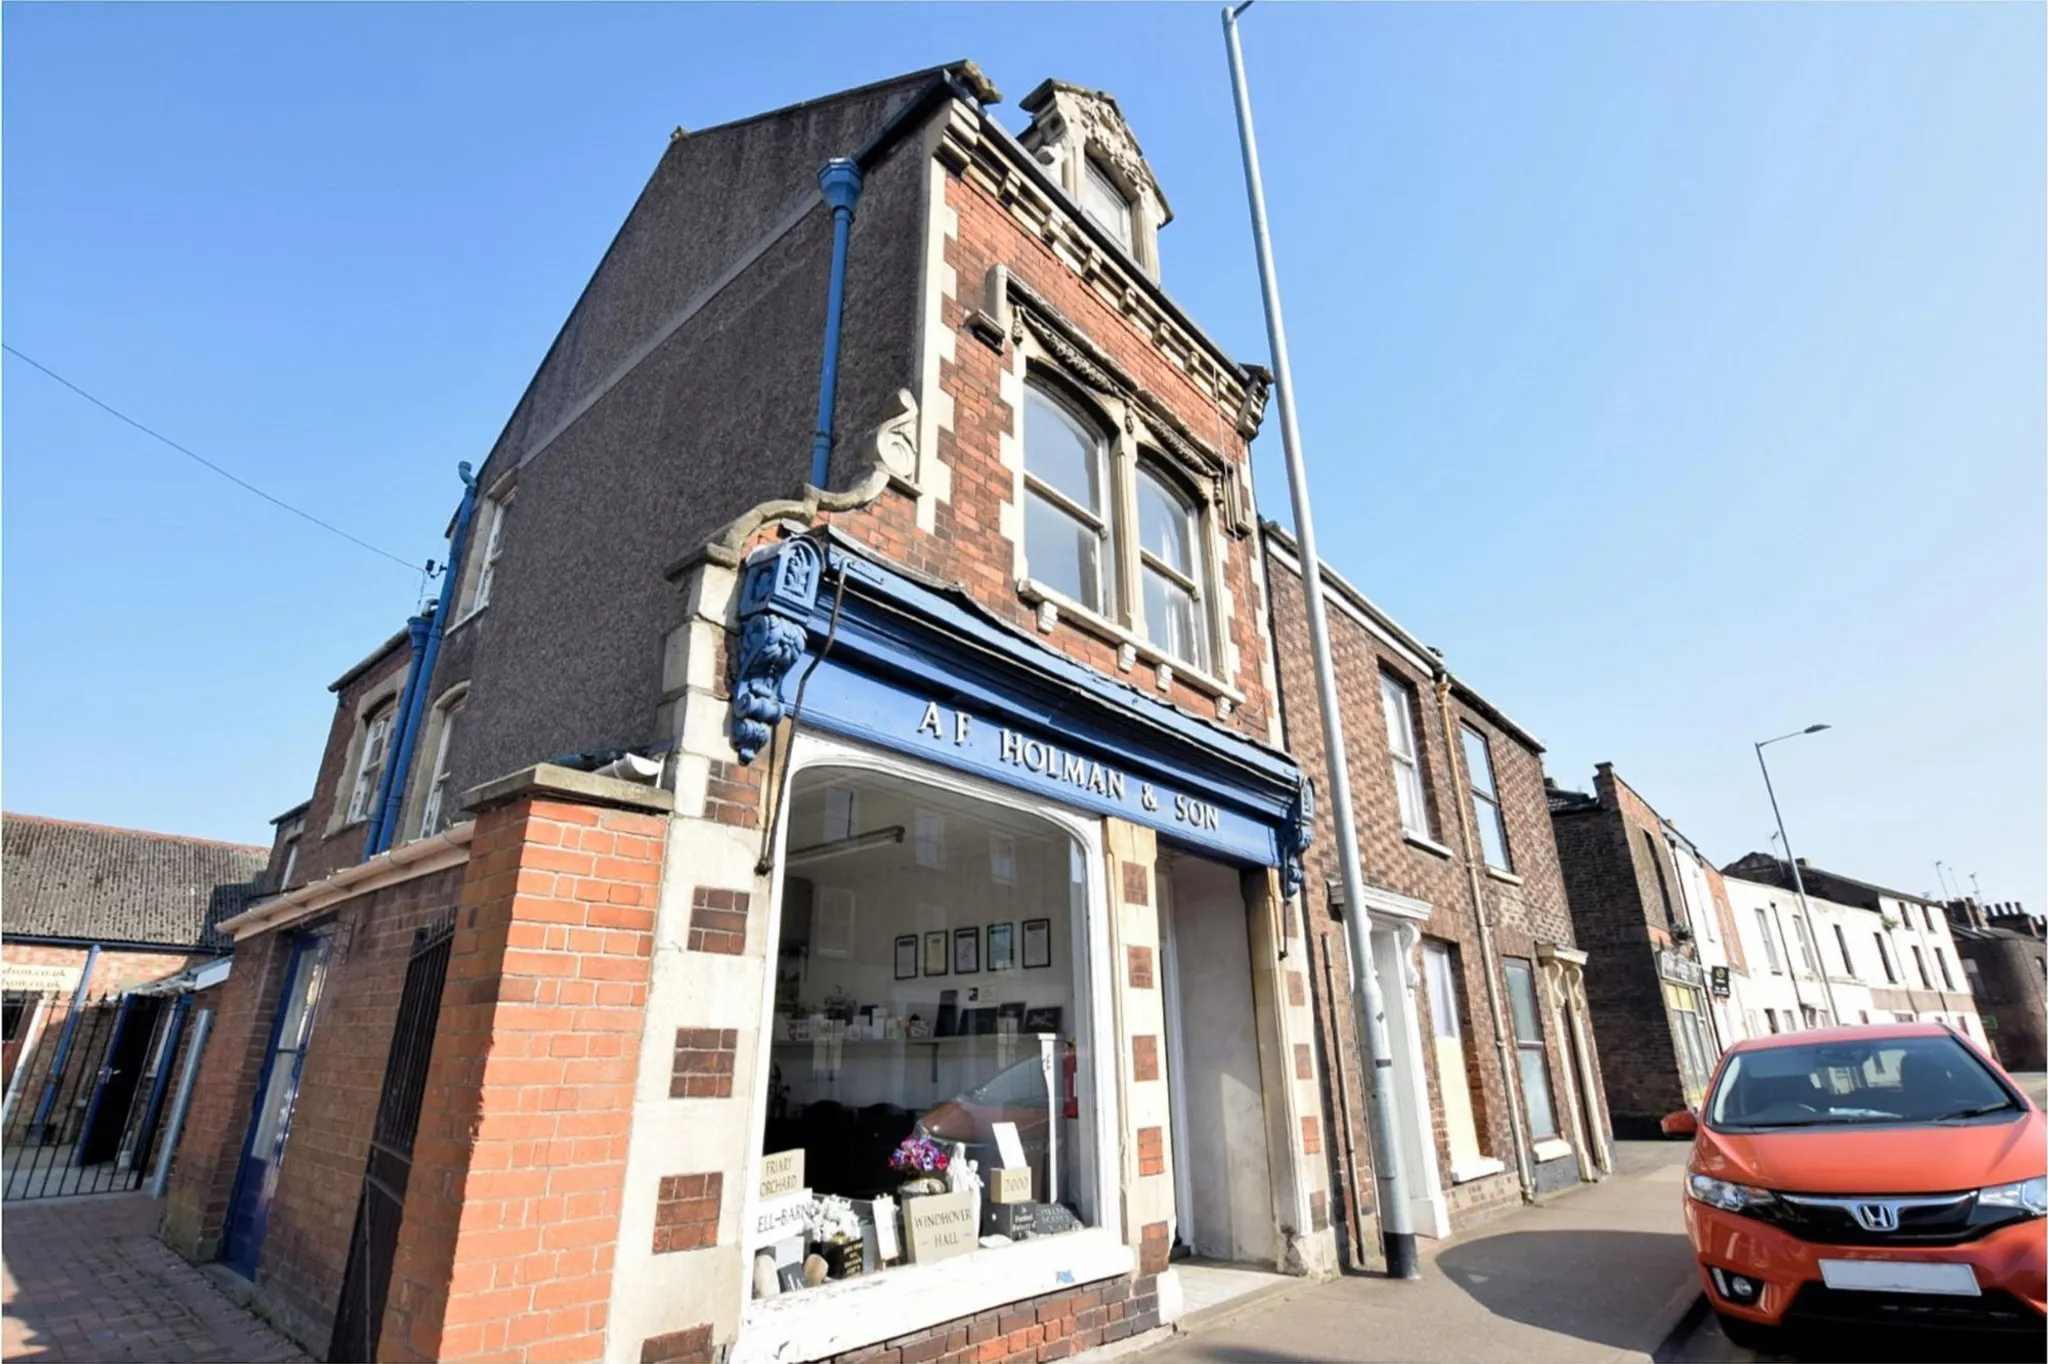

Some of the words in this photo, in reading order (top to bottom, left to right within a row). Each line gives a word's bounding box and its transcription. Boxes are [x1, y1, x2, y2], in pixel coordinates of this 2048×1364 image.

[1000, 728, 1126, 800] HOLMAN
[1141, 782, 1159, 812] &
[1175, 793, 1219, 833] SON
[759, 1174, 798, 1198] ORCHARD
[914, 1208, 972, 1229] WINDHOVER
[934, 1232, 959, 1249] HALL
